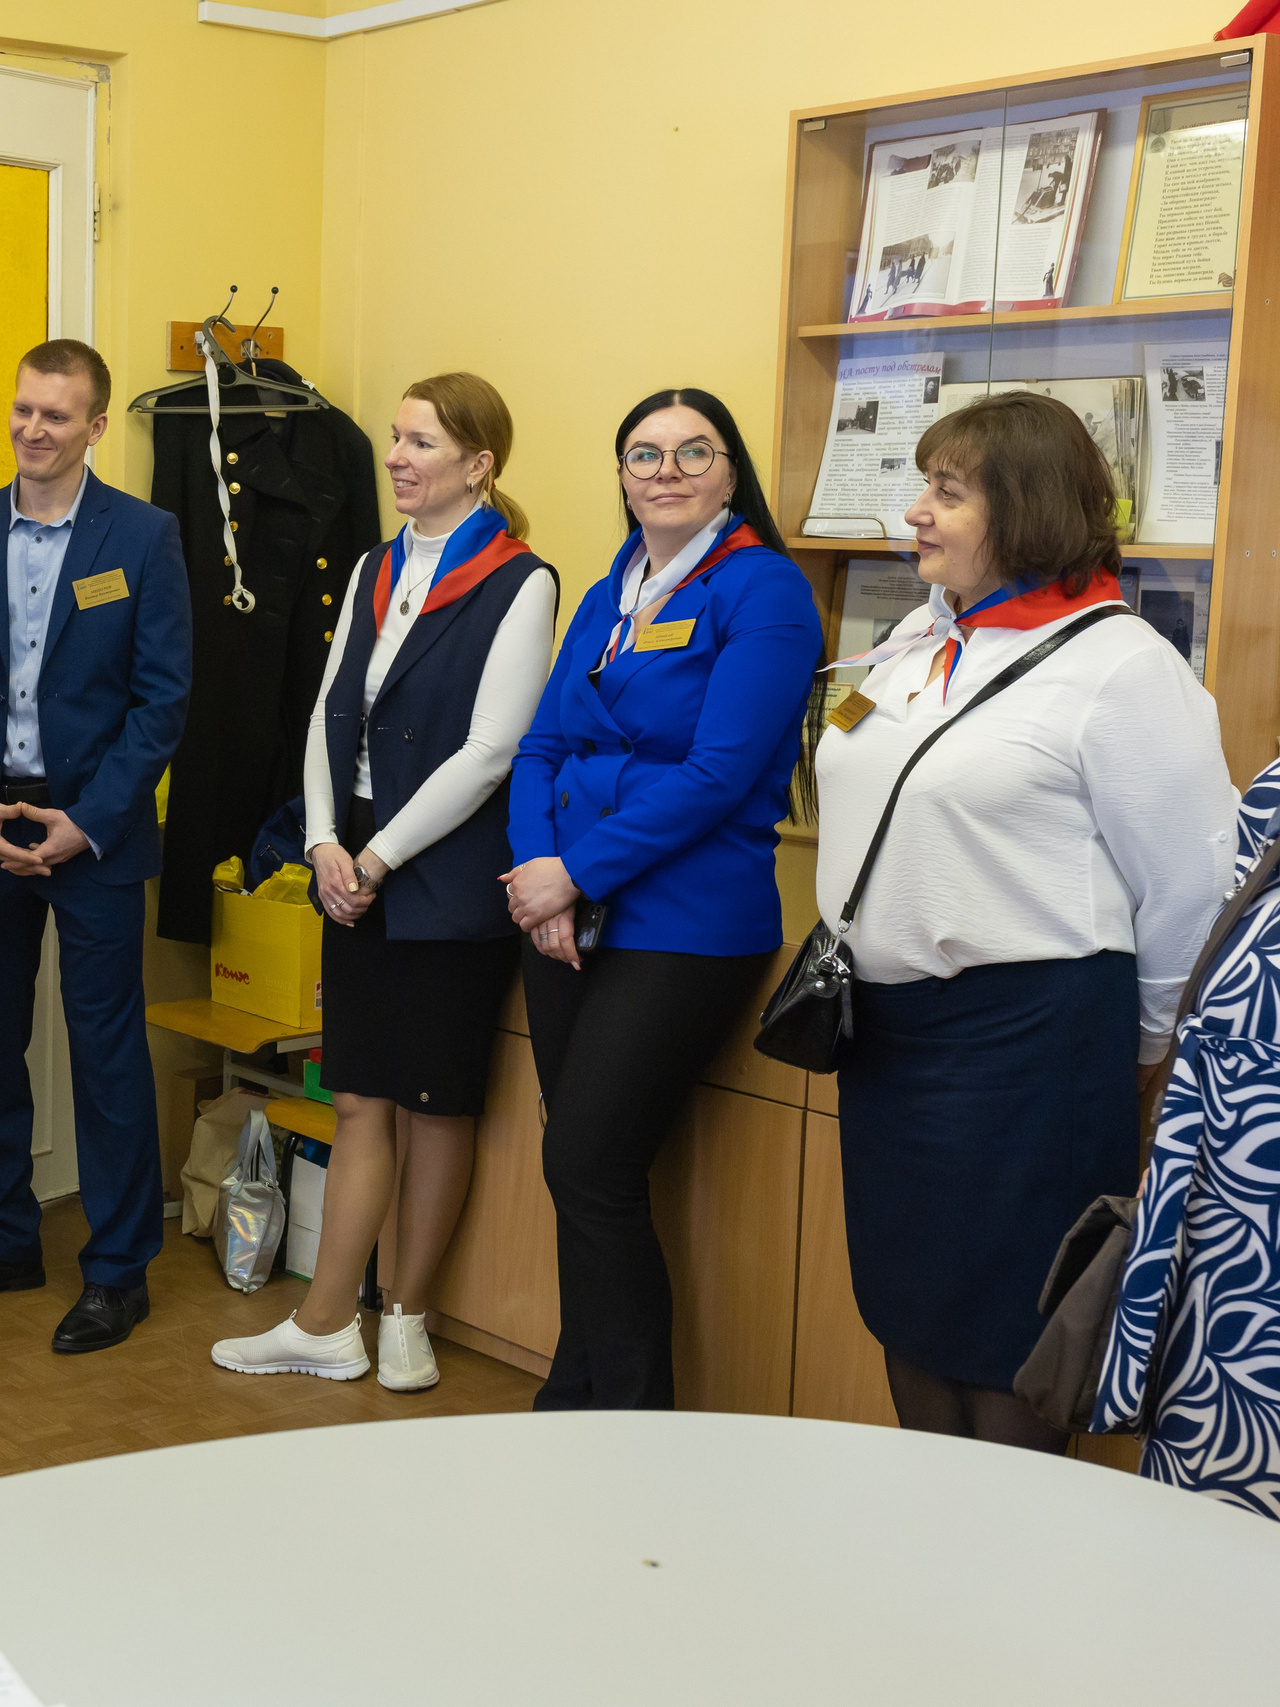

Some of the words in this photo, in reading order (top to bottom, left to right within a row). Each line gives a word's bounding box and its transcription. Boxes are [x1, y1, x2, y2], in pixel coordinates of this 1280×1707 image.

[837, 367, 853, 382] НА
[855, 366, 880, 376] посту
[881, 361, 897, 372] под
[897, 360, 941, 375] обстрелом
